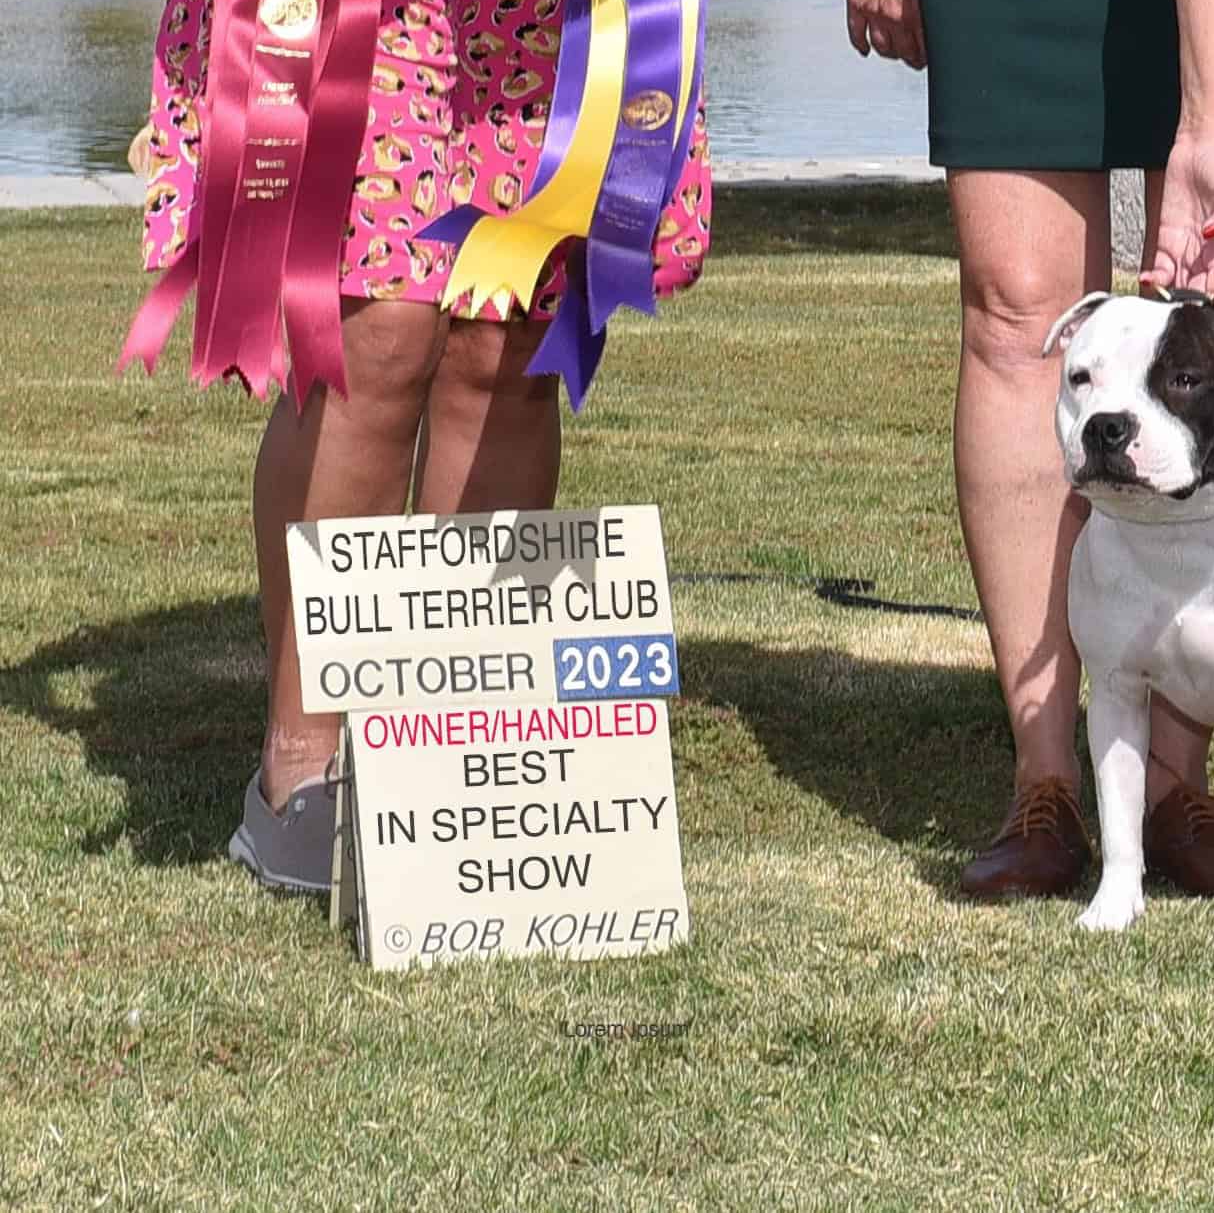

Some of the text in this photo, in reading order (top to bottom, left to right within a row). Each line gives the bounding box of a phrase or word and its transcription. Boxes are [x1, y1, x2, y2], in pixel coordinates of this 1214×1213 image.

[331, 518, 625, 573] STAFFORDSHIRE
[305, 579, 659, 635] BULL TERRIER CLUB
[320, 642, 673, 698] OCTOBER 2023
[363, 703, 657, 749] OWNER/HANDLED
[463, 749, 575, 787] BEST
[377, 796, 668, 845] IN SPECIALTY
[457, 853, 592, 893] SHOW
[421, 918, 505, 954] BOB
[525, 908, 679, 947] KOHLER
